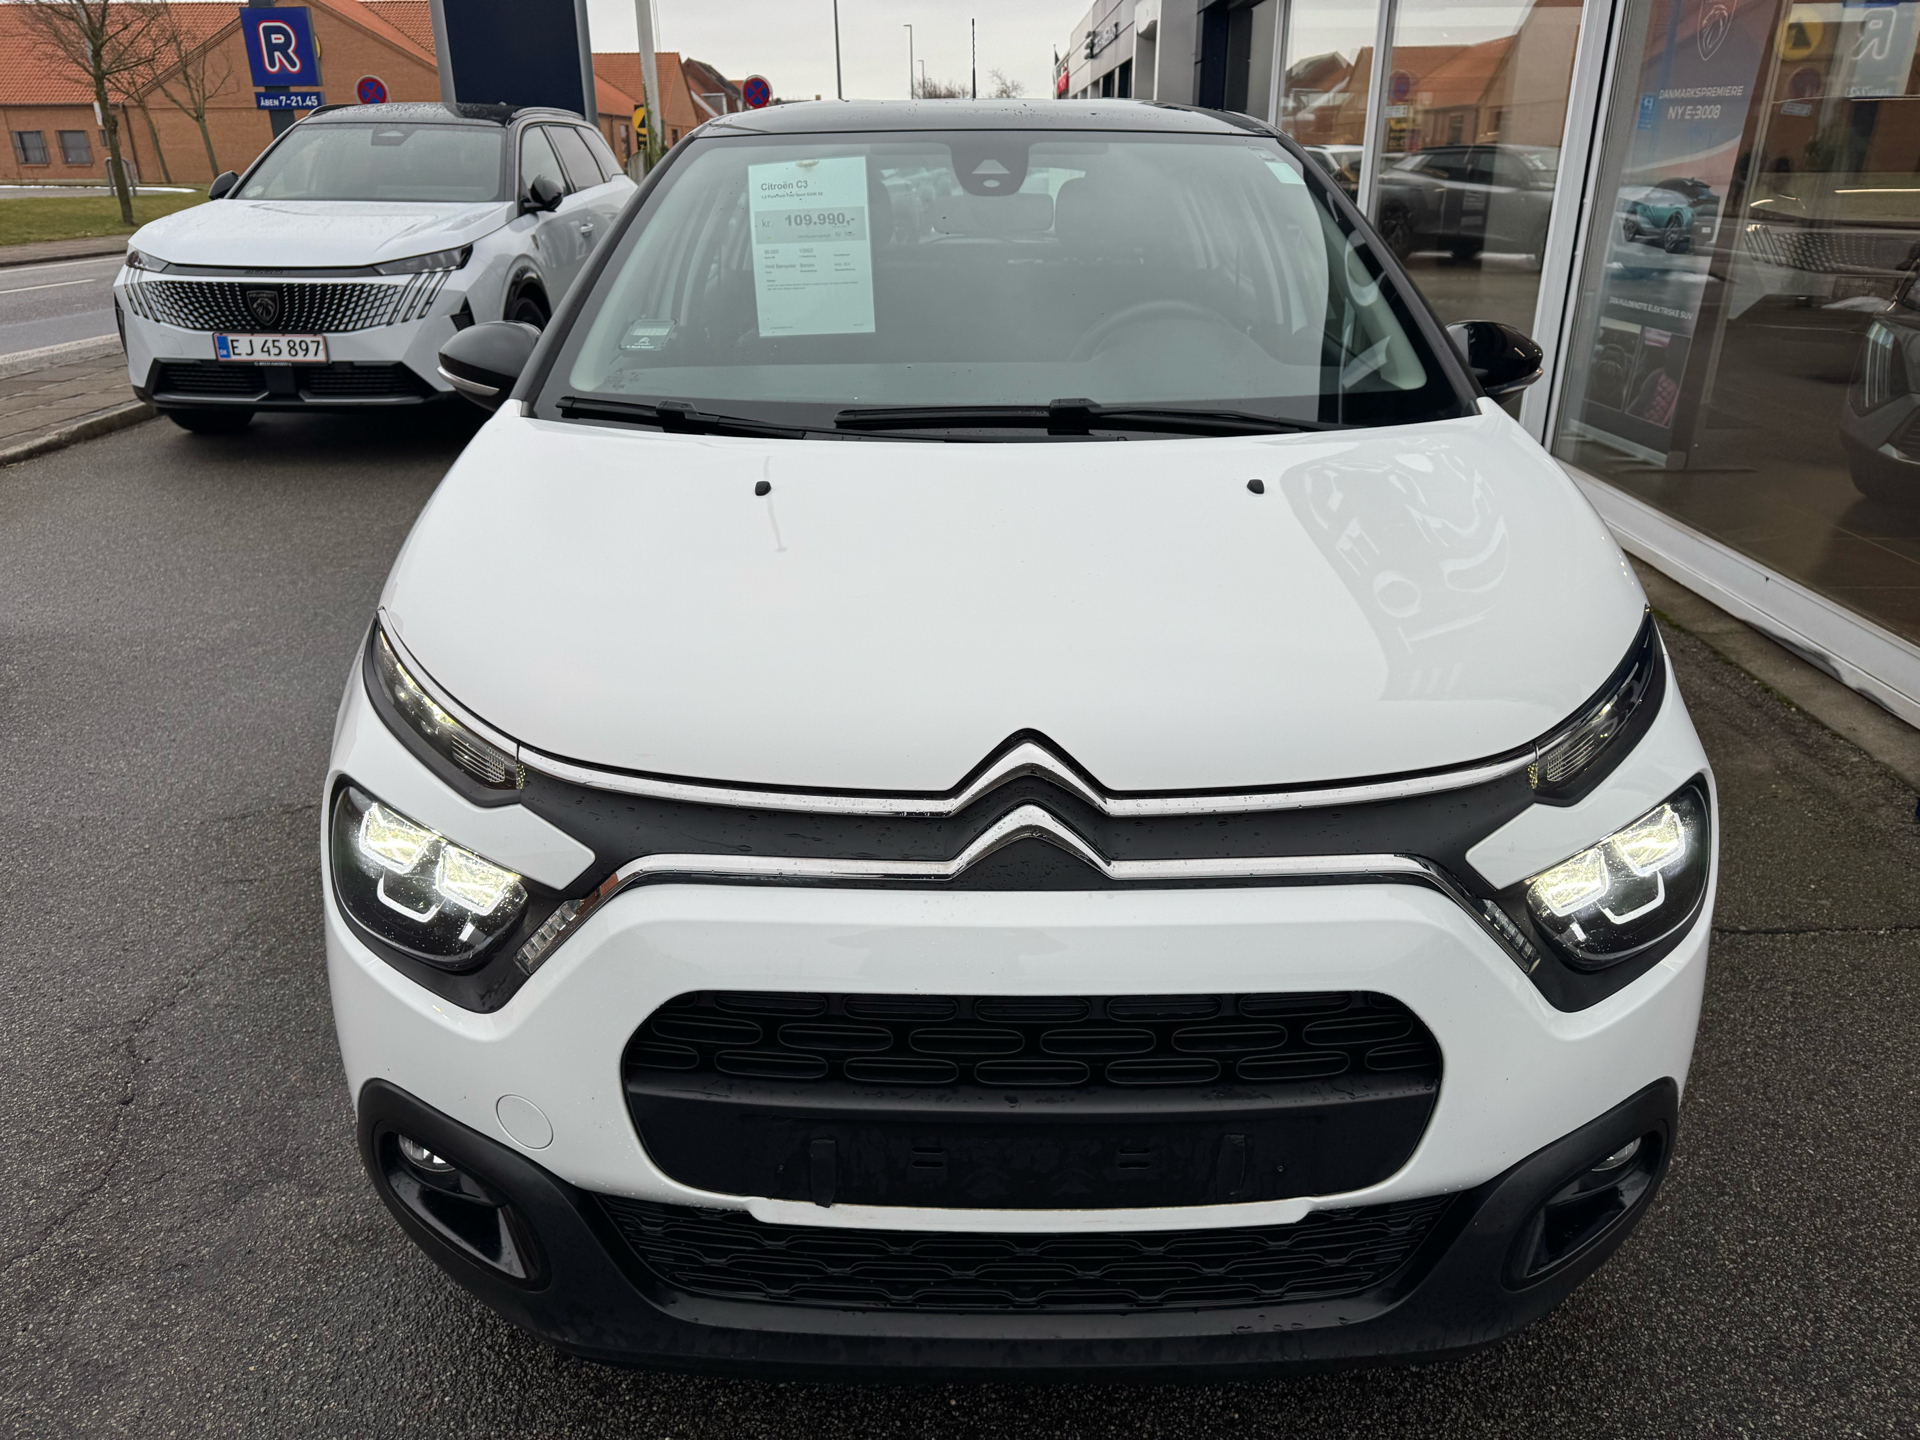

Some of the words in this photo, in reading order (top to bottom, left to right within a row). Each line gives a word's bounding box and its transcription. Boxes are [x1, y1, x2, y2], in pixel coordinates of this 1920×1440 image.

[257, 20, 302, 74] R
[1659, 85, 1744, 99] DANMARKSPREMIERE
[260, 96, 279, 106] ÅBEN
[279, 95, 318, 107] 7-21.45
[1668, 106, 1685, 119] NY
[1685, 105, 1721, 119] E-3008
[761, 181, 793, 191] Citroën
[796, 180, 808, 189] C3
[785, 212, 855, 227] 109.990,-
[1680, 310, 1694, 319] SUV
[261, 339, 282, 356] 45
[287, 339, 321, 357] 897
